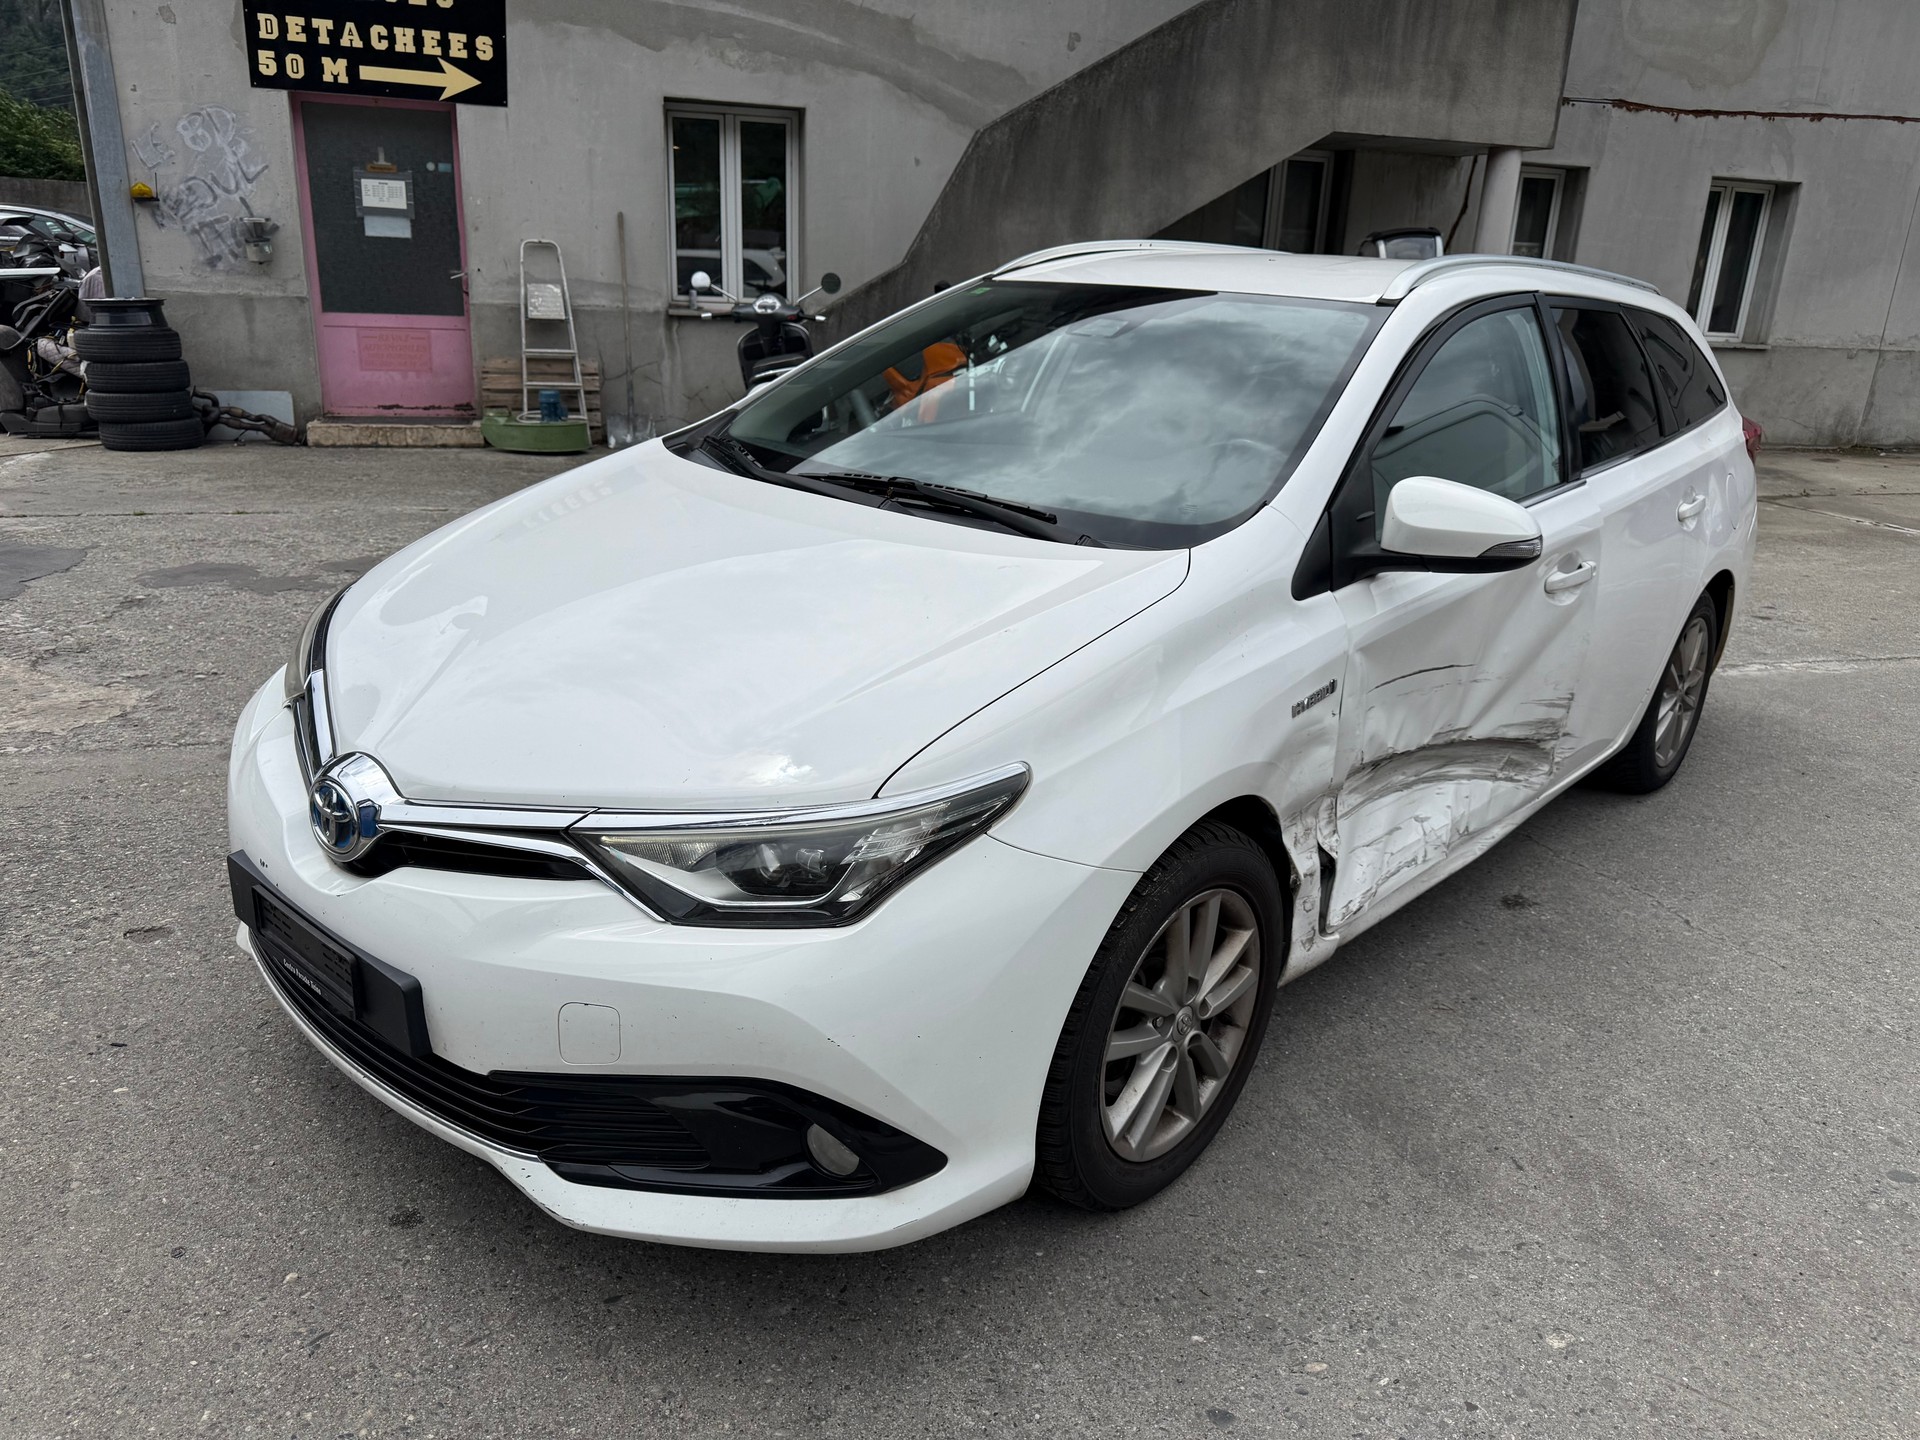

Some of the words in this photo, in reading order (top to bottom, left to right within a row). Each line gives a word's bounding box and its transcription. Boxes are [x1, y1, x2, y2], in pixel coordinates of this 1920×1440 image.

[257, 12, 494, 61] DETACHEES
[257, 50, 305, 79] 50
[321, 56, 349, 84] M
